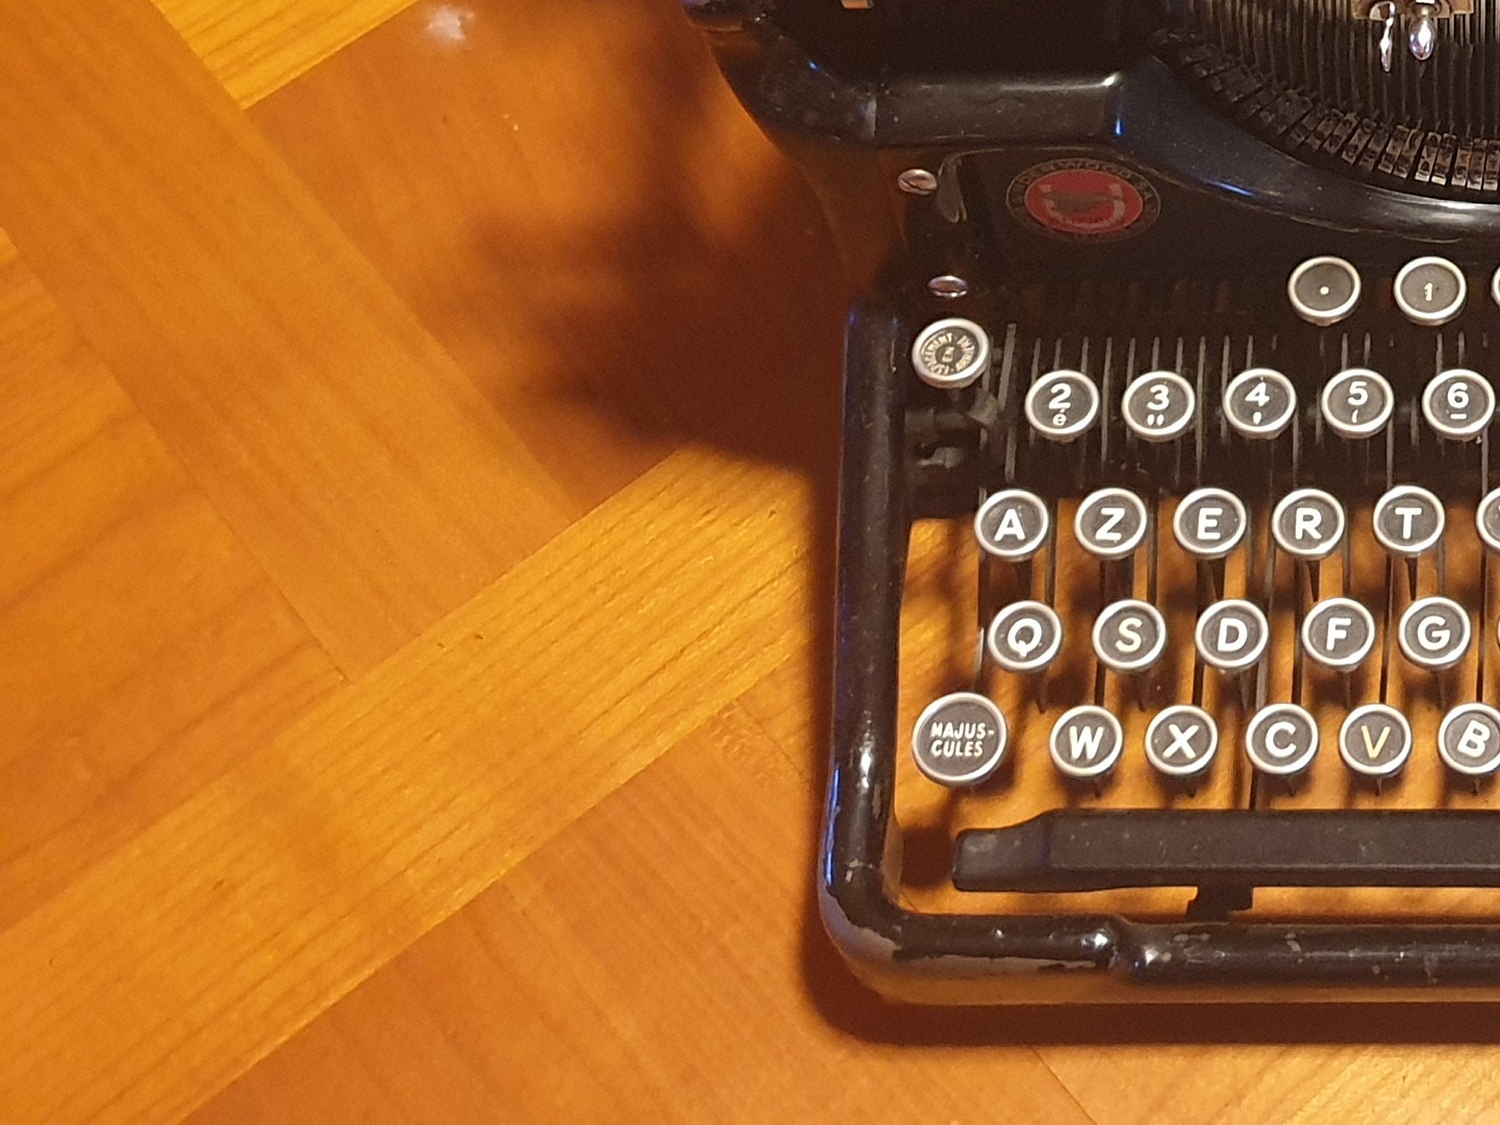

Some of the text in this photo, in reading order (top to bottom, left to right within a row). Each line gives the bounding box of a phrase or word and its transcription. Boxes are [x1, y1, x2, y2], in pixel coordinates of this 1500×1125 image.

[1048, 382, 1072, 410] 2
[1146, 384, 1170, 411] 3
[1244, 381, 1271, 407] 4
[1347, 380, 1369, 406] 5
[1447, 382, 1470, 409] 6
[994, 508, 1026, 542] A
[1095, 507, 1126, 543] Z
[1197, 507, 1223, 540] E
[1295, 507, 1322, 540] R
[1394, 507, 1423, 540] T
[1007, 617, 1043, 658] Q
[1115, 617, 1143, 653] S
[1217, 617, 1248, 652] D
[1326, 617, 1352, 651] F
[1417, 616, 1451, 651] G
[930, 722, 994, 739] MAJUS-
[1069, 725, 1104, 760] W
[1162, 724, 1200, 759] X
[1265, 721, 1297, 758] C
[1360, 725, 1391, 759] V
[1457, 719, 1491, 758] B
[931, 739, 983, 757] CULES
